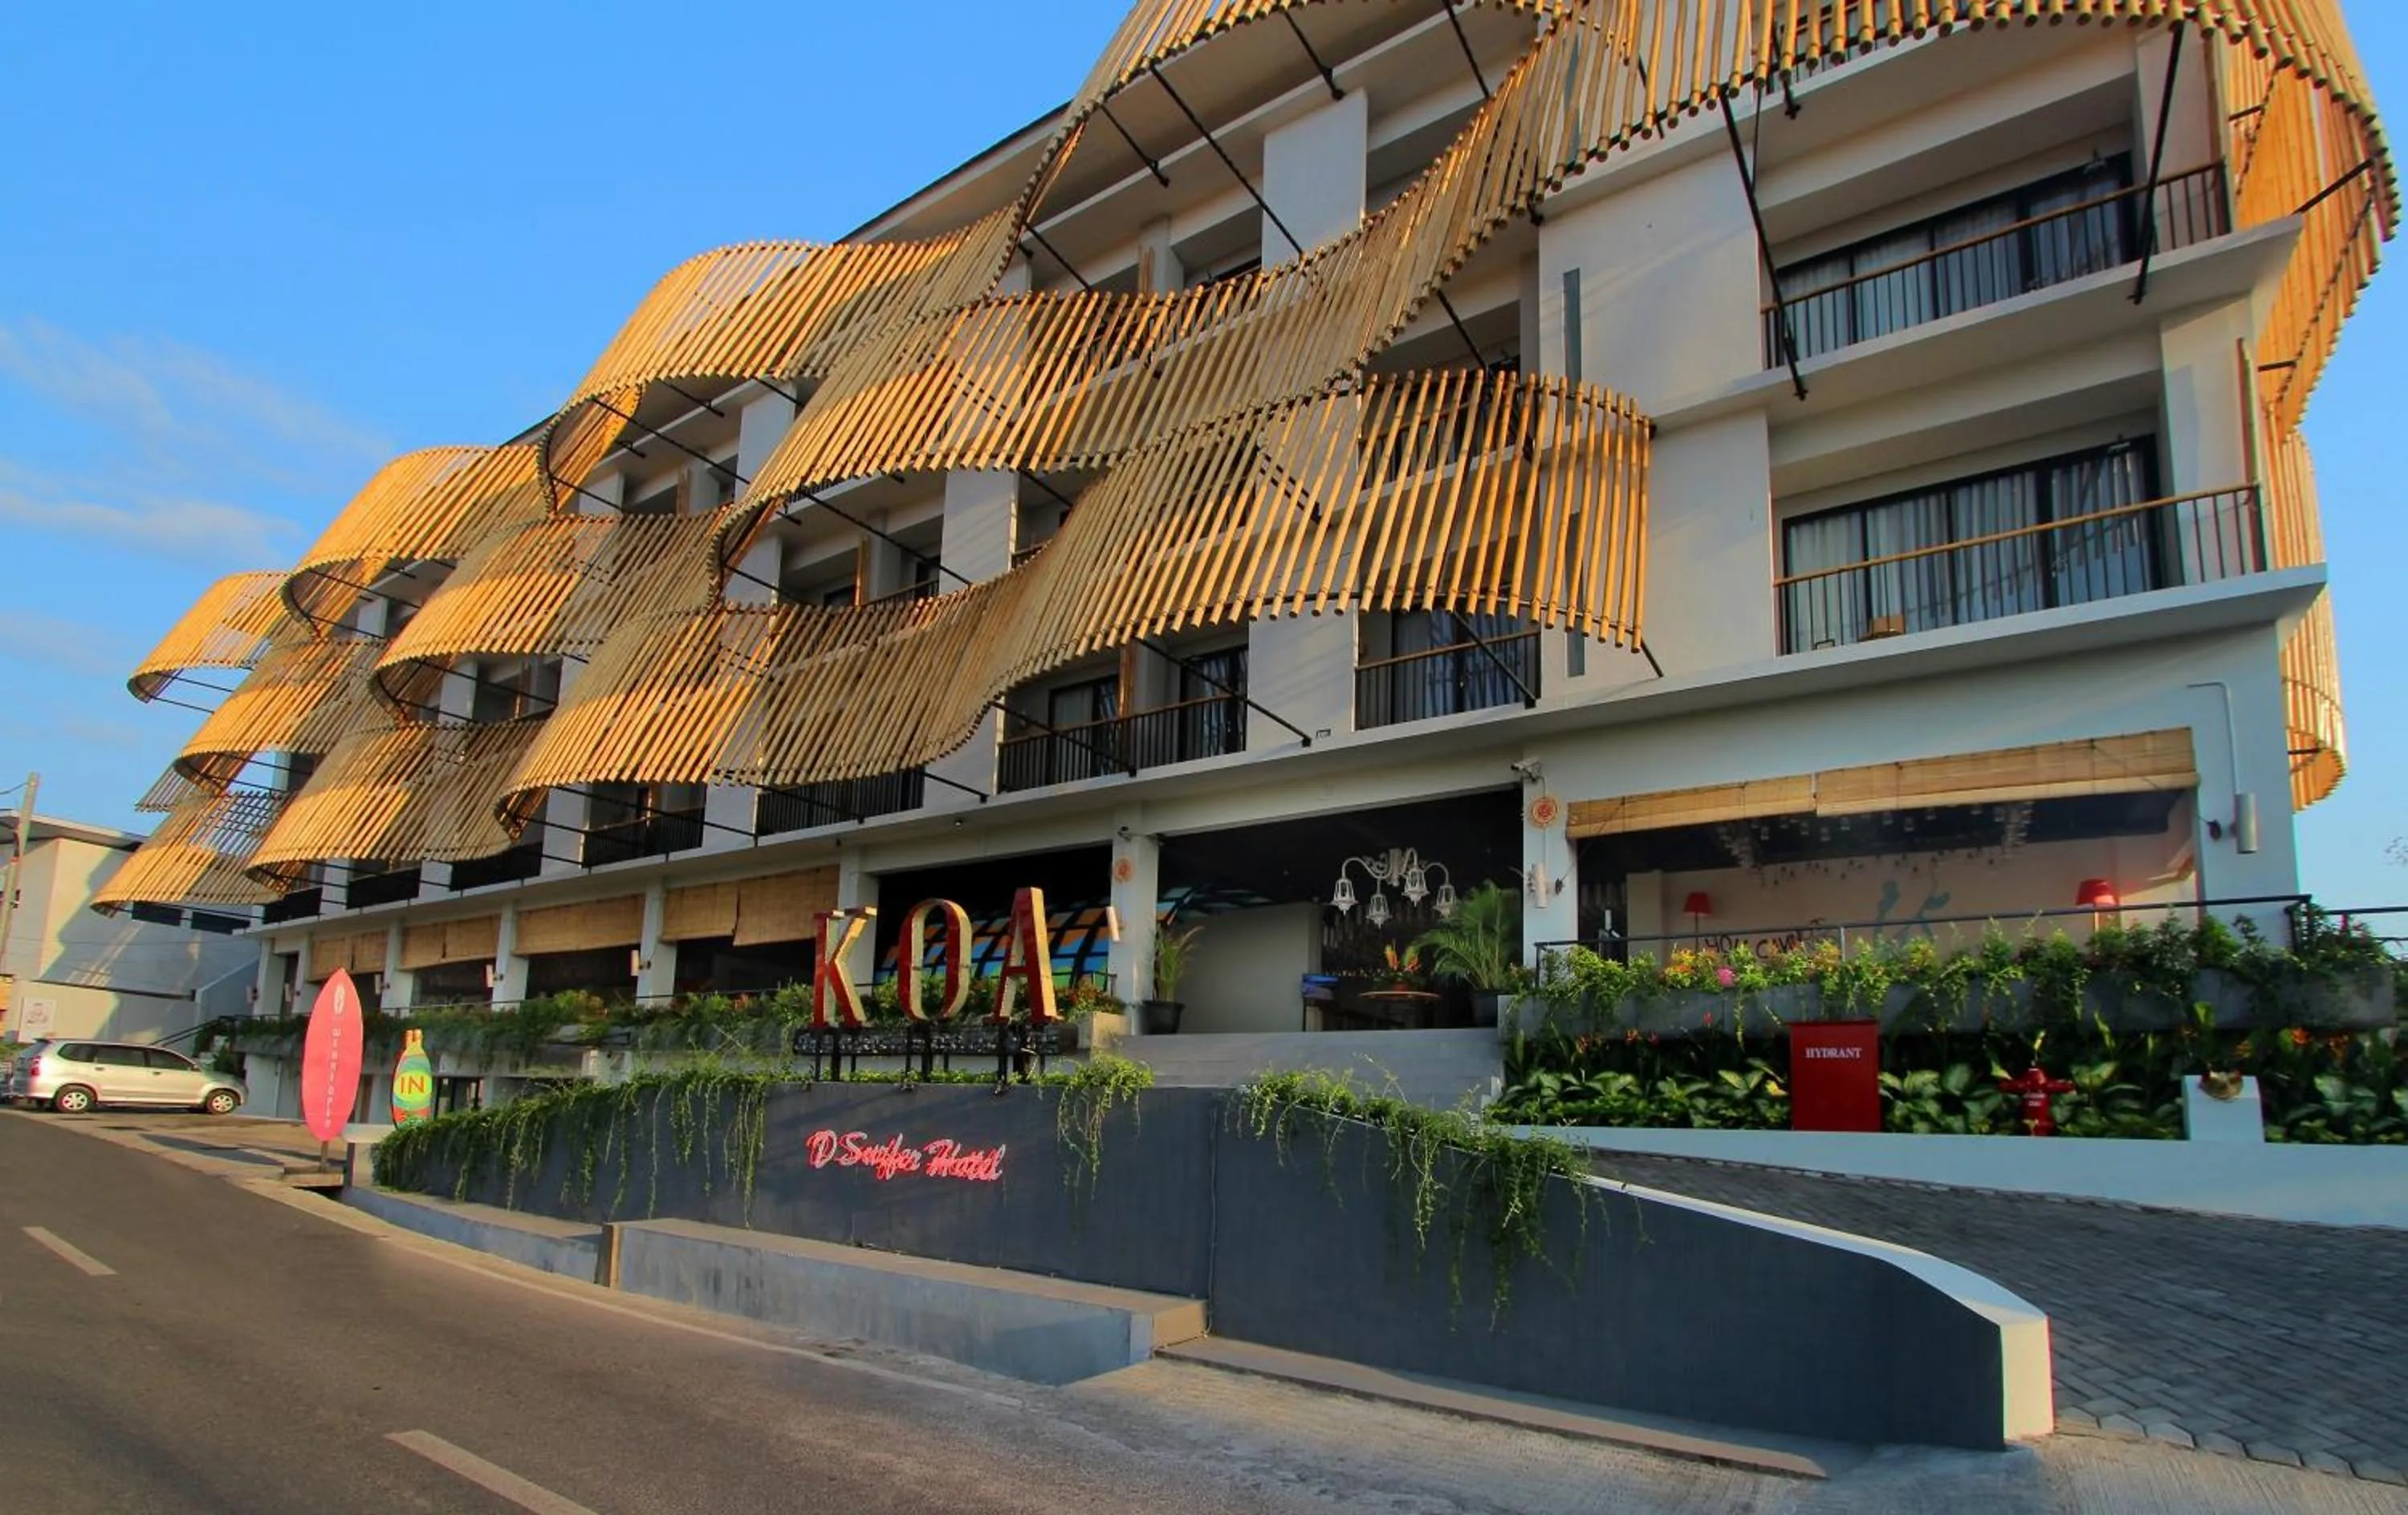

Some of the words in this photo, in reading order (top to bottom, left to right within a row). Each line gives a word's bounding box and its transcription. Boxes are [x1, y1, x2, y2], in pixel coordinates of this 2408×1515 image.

[812, 887, 1066, 1029] KOA
[1804, 1046, 1862, 1059] HYDRANT
[401, 1075, 425, 1094] IN
[923, 1138, 1007, 1181] Hotel
